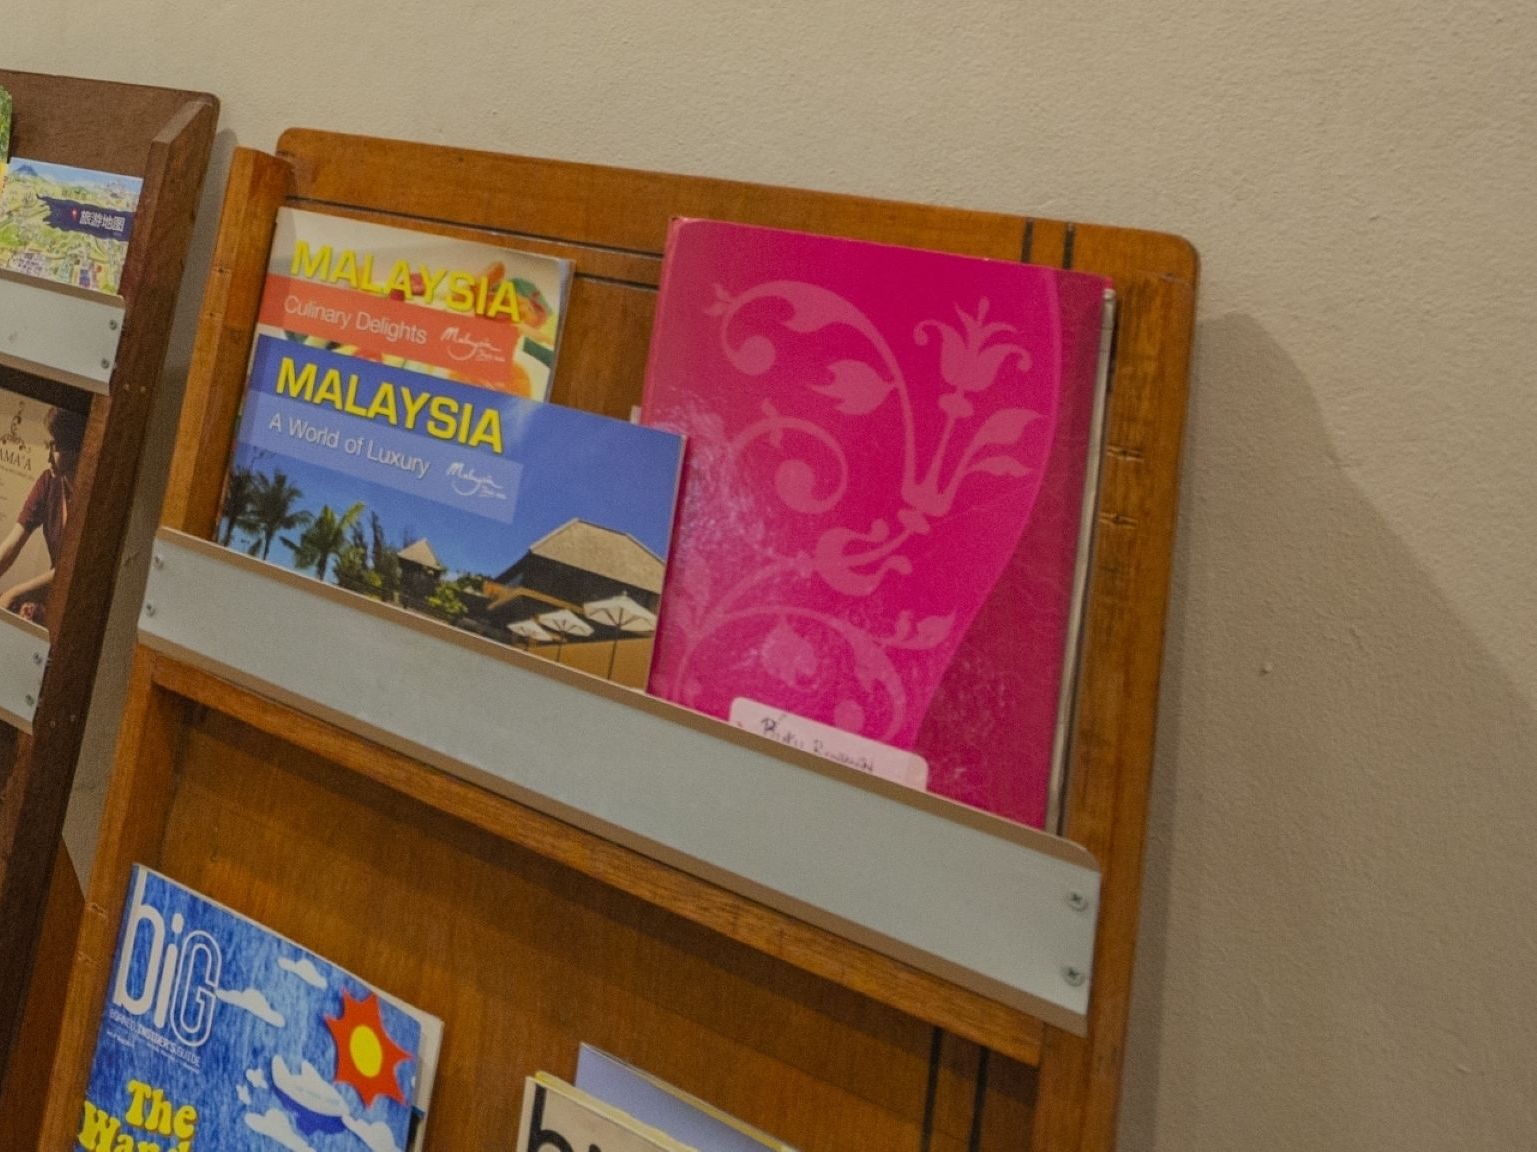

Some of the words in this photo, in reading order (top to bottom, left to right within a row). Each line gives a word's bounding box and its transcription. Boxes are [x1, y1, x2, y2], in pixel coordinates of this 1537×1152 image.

[290, 240, 522, 323] MALAYSIA
[284, 295, 352, 330] Culinary
[355, 311, 427, 344] Delights
[276, 357, 505, 454] MALAYSIA
[268, 413, 282, 433] A
[288, 417, 340, 448] World
[344, 436, 365, 456] of
[366, 441, 431, 479] Luxury
[125, 1079, 197, 1139] The
